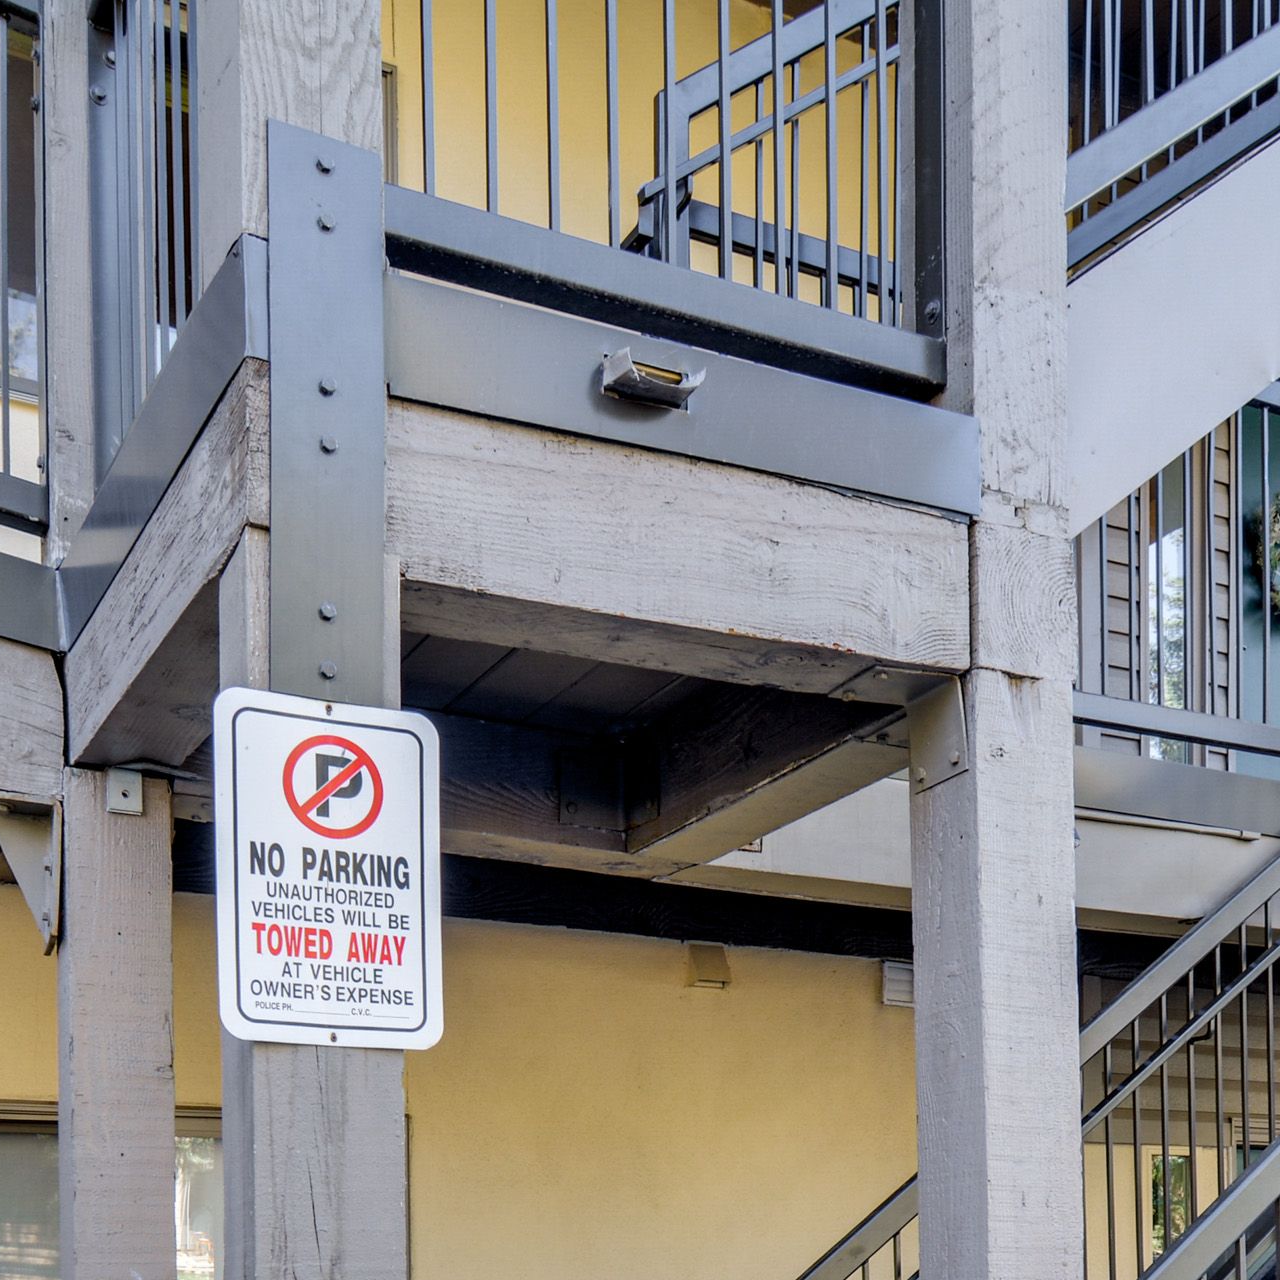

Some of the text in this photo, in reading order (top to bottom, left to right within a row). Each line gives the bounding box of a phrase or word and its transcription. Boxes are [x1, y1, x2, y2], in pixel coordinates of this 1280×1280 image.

[250, 841, 410, 890] NO PARKING
[266, 881, 395, 909] UNAUTHORIZED
[251, 901, 410, 931] VEHICLES WILL BE
[251, 922, 406, 966] TOWED AWAY
[281, 961, 384, 985] AT VEHICLE
[250, 979, 414, 1007] OWNER'S EXPENSE
[255, 1000, 372, 1017] POLICE PH. C.V.C.
